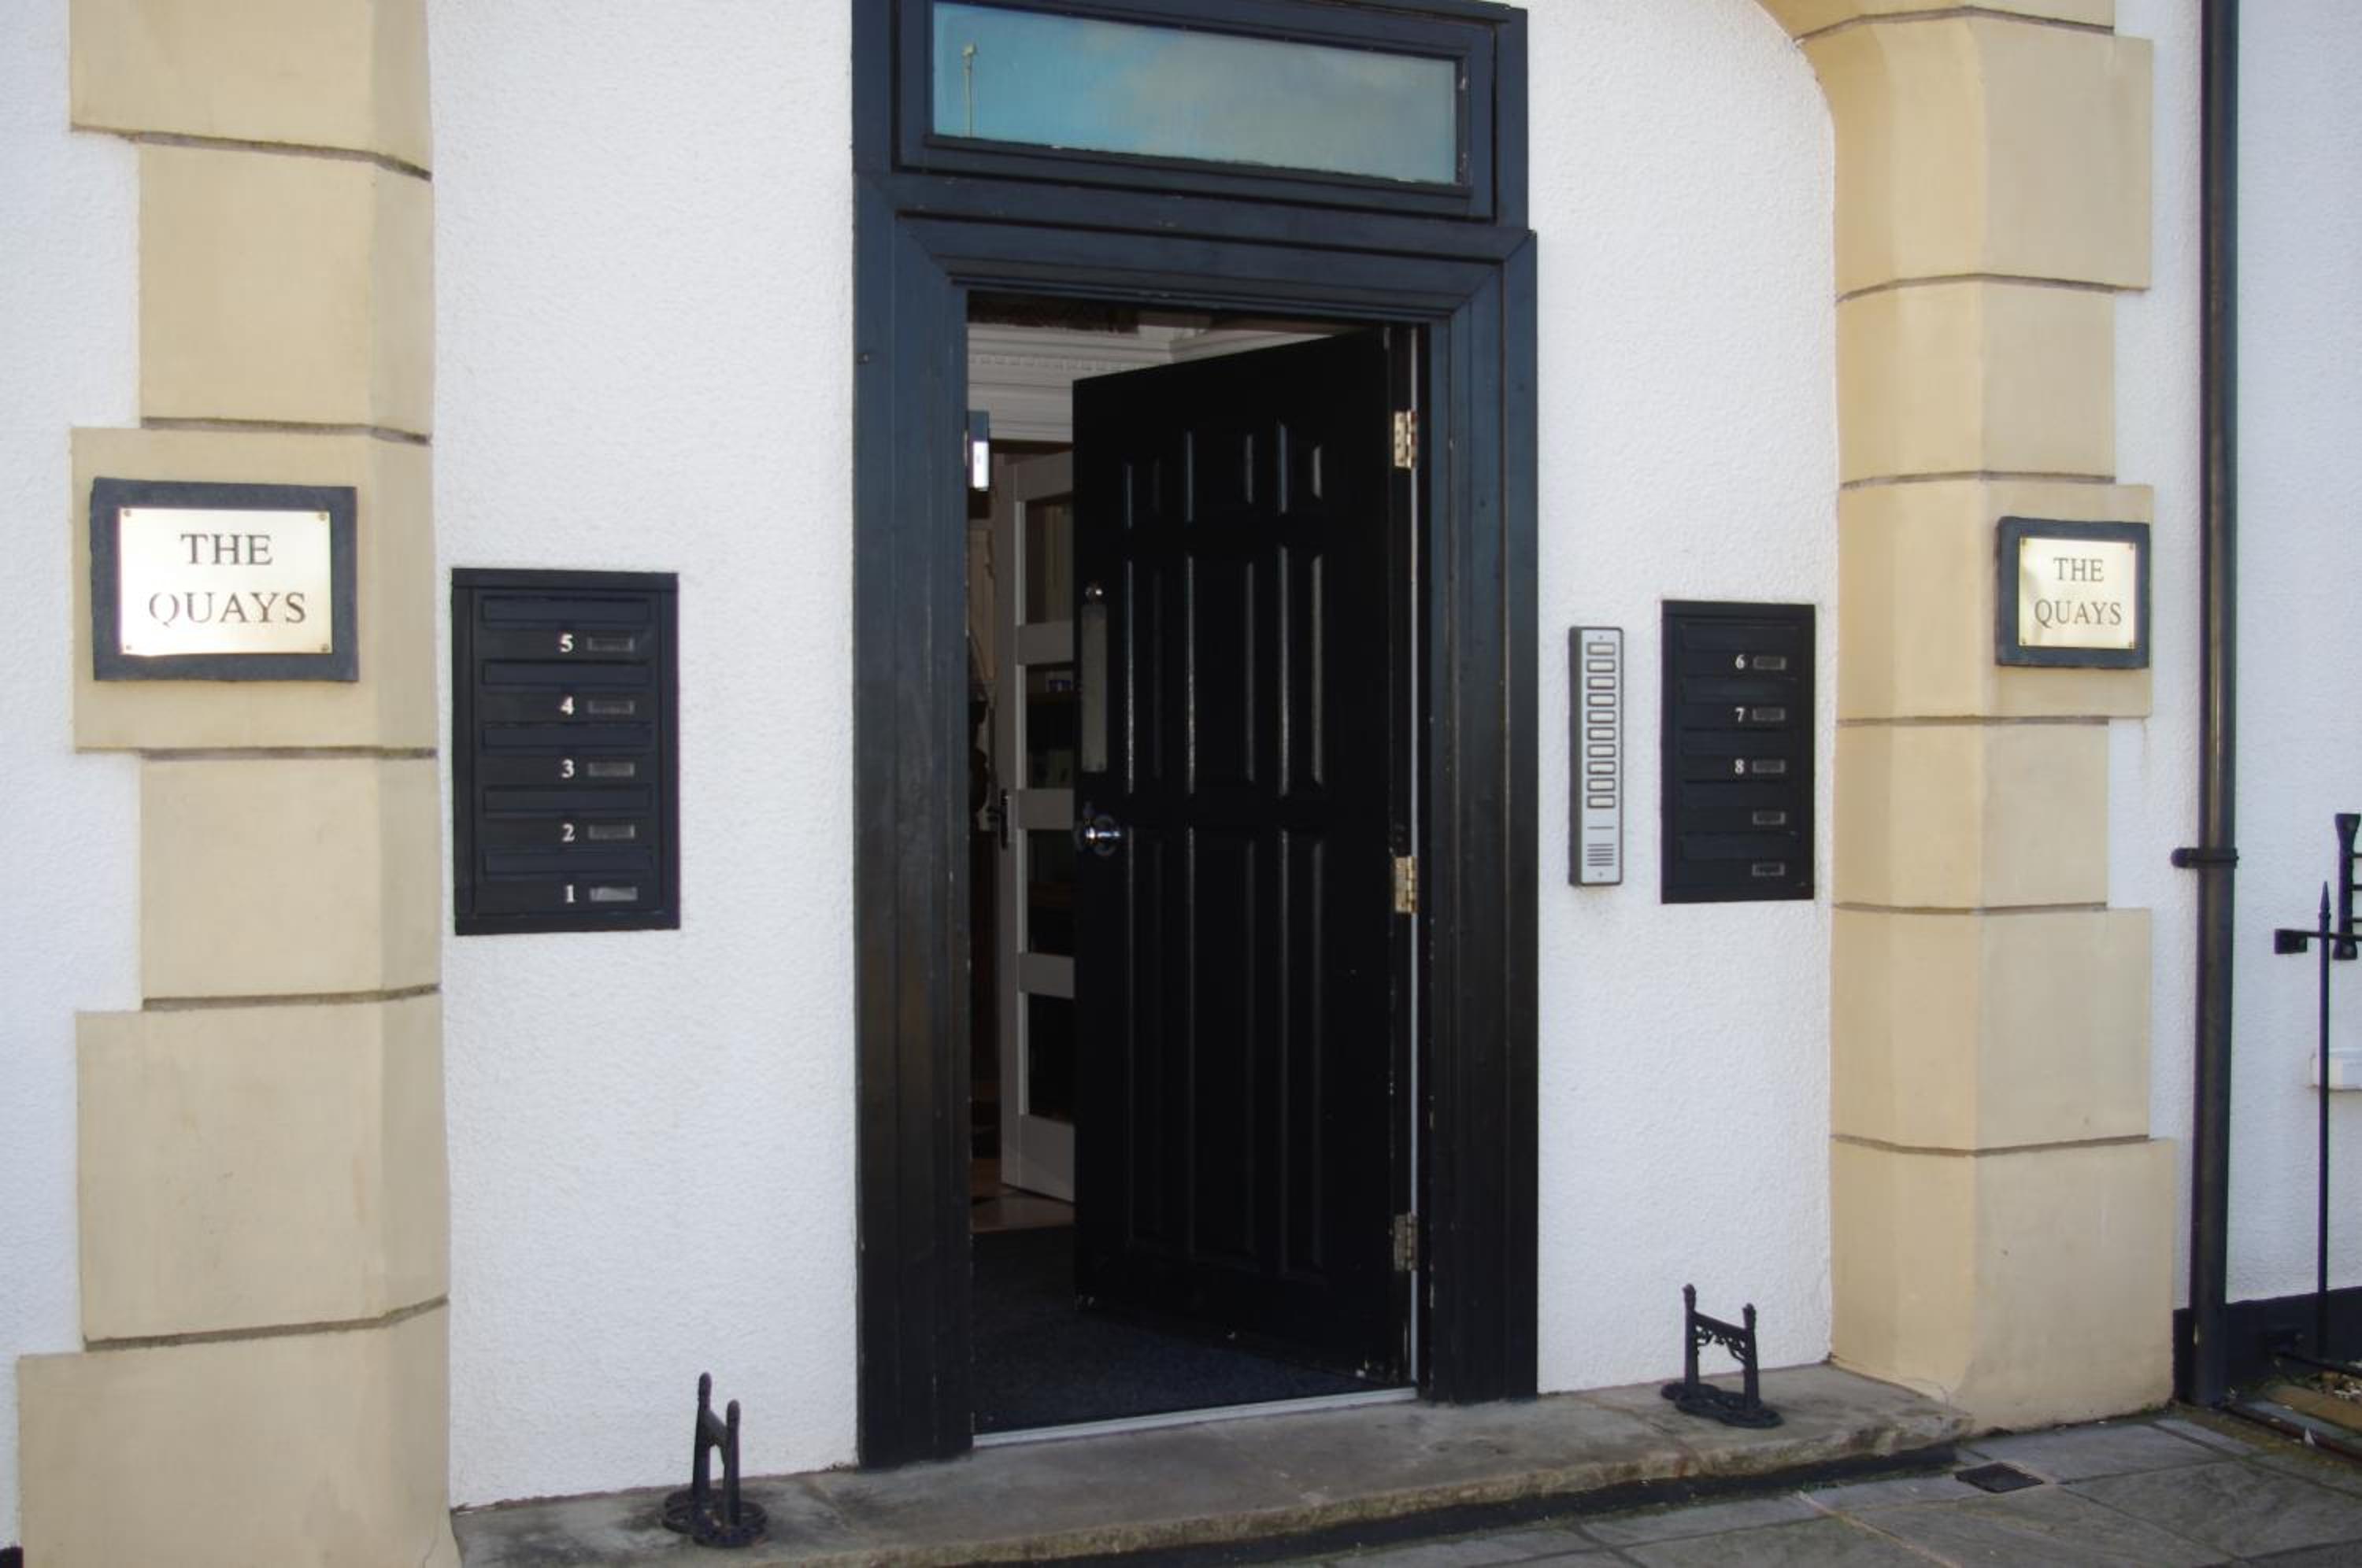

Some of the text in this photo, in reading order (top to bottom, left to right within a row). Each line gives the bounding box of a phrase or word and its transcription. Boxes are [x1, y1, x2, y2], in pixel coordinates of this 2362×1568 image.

[180, 532, 273, 566] THE
[2053, 557, 2105, 582] THE
[148, 591, 307, 627] QUAYS
[2034, 598, 2122, 628] QUAYS
[560, 633, 574, 653] 5
[1735, 654, 1746, 669] 6
[560, 696, 575, 716] 4
[1735, 708, 1745, 722] 7
[561, 759, 575, 778] 3
[1734, 759, 1745, 775] 8
[561, 823, 576, 842] 2
[565, 885, 576, 904] 1
